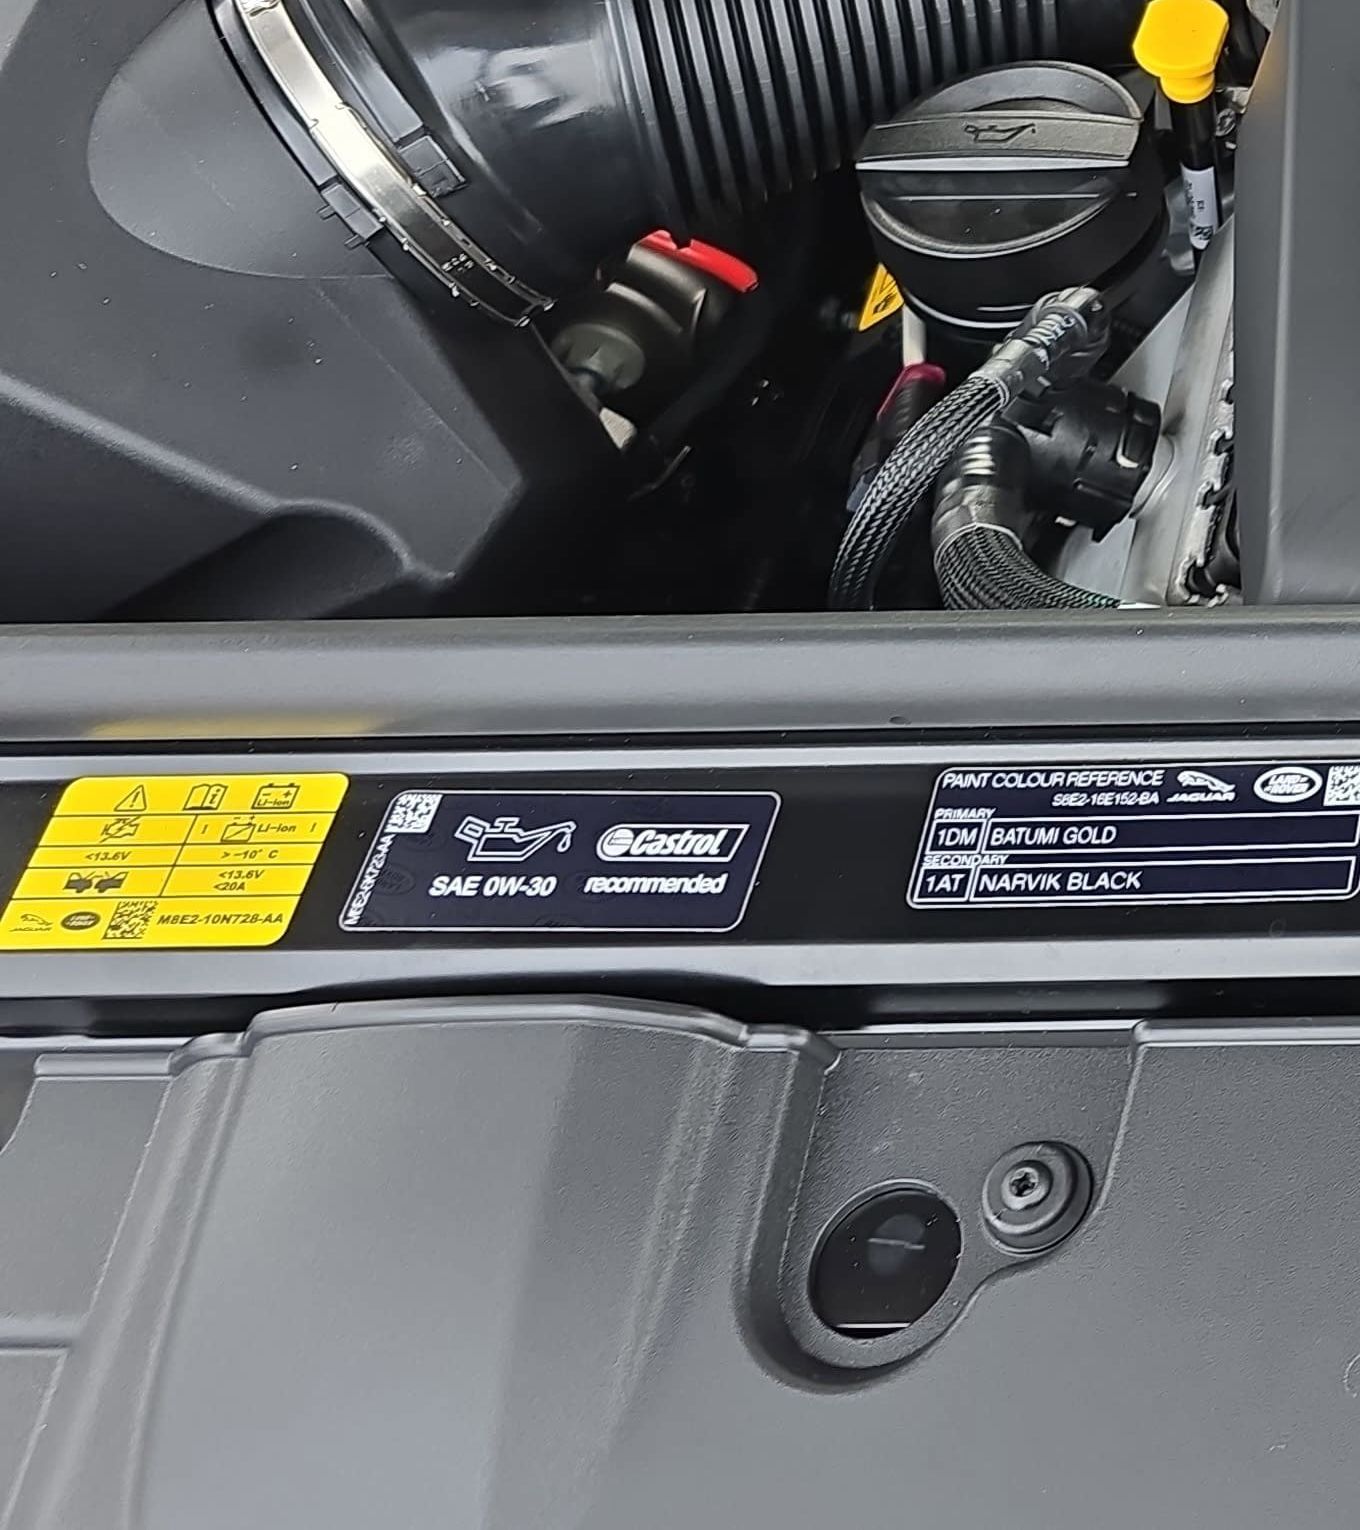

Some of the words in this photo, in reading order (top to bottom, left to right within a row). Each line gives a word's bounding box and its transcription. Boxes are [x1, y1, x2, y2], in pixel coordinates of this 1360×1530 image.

[942, 772, 993, 789] PAINT
[992, 771, 1066, 789] COLOUR
[1066, 770, 1165, 787] REFERENCE
[1166, 792, 1236, 803] JAGUAR
[934, 808, 996, 819] PRIMARY
[629, 829, 729, 856] Castrol
[937, 827, 978, 846] 1DM
[990, 827, 1059, 846] BATUMI
[1063, 826, 1117, 845] GOLD
[923, 855, 1009, 866] SECONDARY
[428, 876, 483, 897] SAE
[483, 876, 558, 897] 0W-30
[583, 873, 729, 894] recommended
[926, 874, 967, 893] 1AT
[978, 872, 1061, 892] NARVIK
[1066, 871, 1142, 890] BLACK
